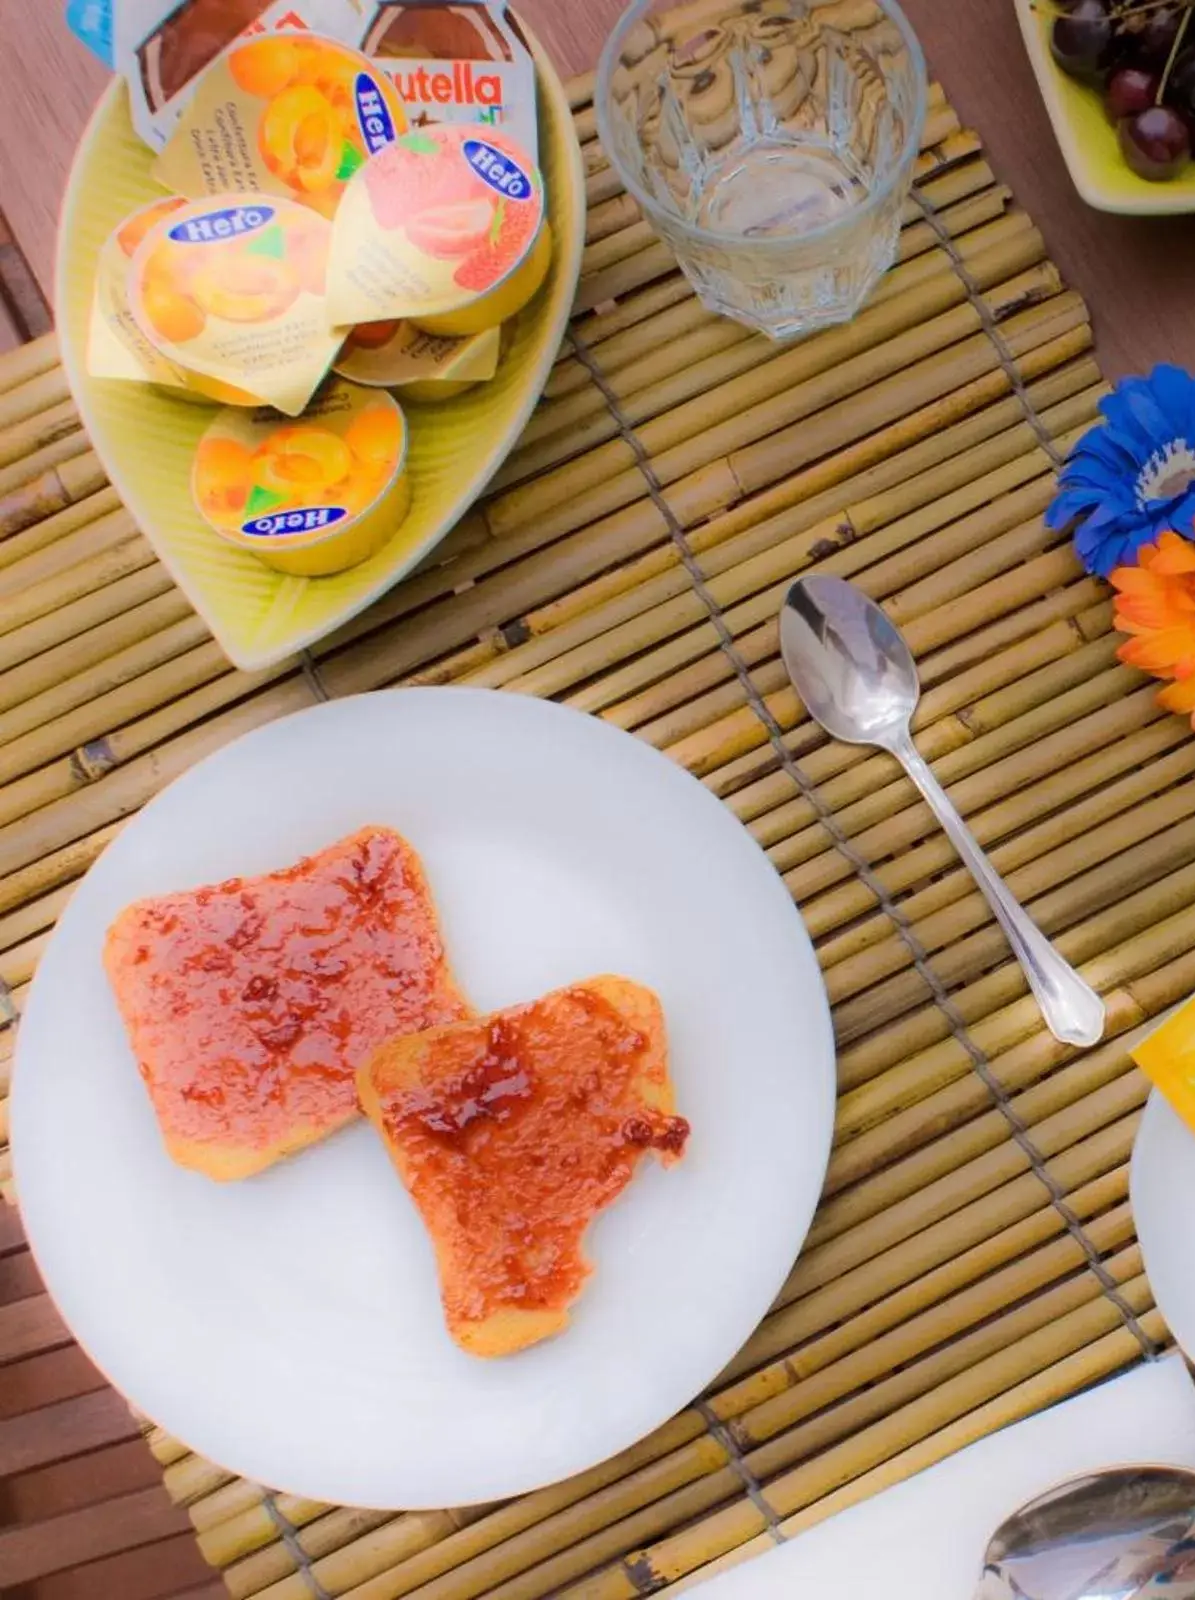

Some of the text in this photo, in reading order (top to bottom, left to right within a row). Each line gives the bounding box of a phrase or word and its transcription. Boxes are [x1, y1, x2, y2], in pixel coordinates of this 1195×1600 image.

[385, 62, 502, 105] utella
[358, 91, 388, 151] Her
[470, 146, 523, 195] Hero
[187, 209, 263, 241] Hero
[255, 509, 330, 535] Hero
